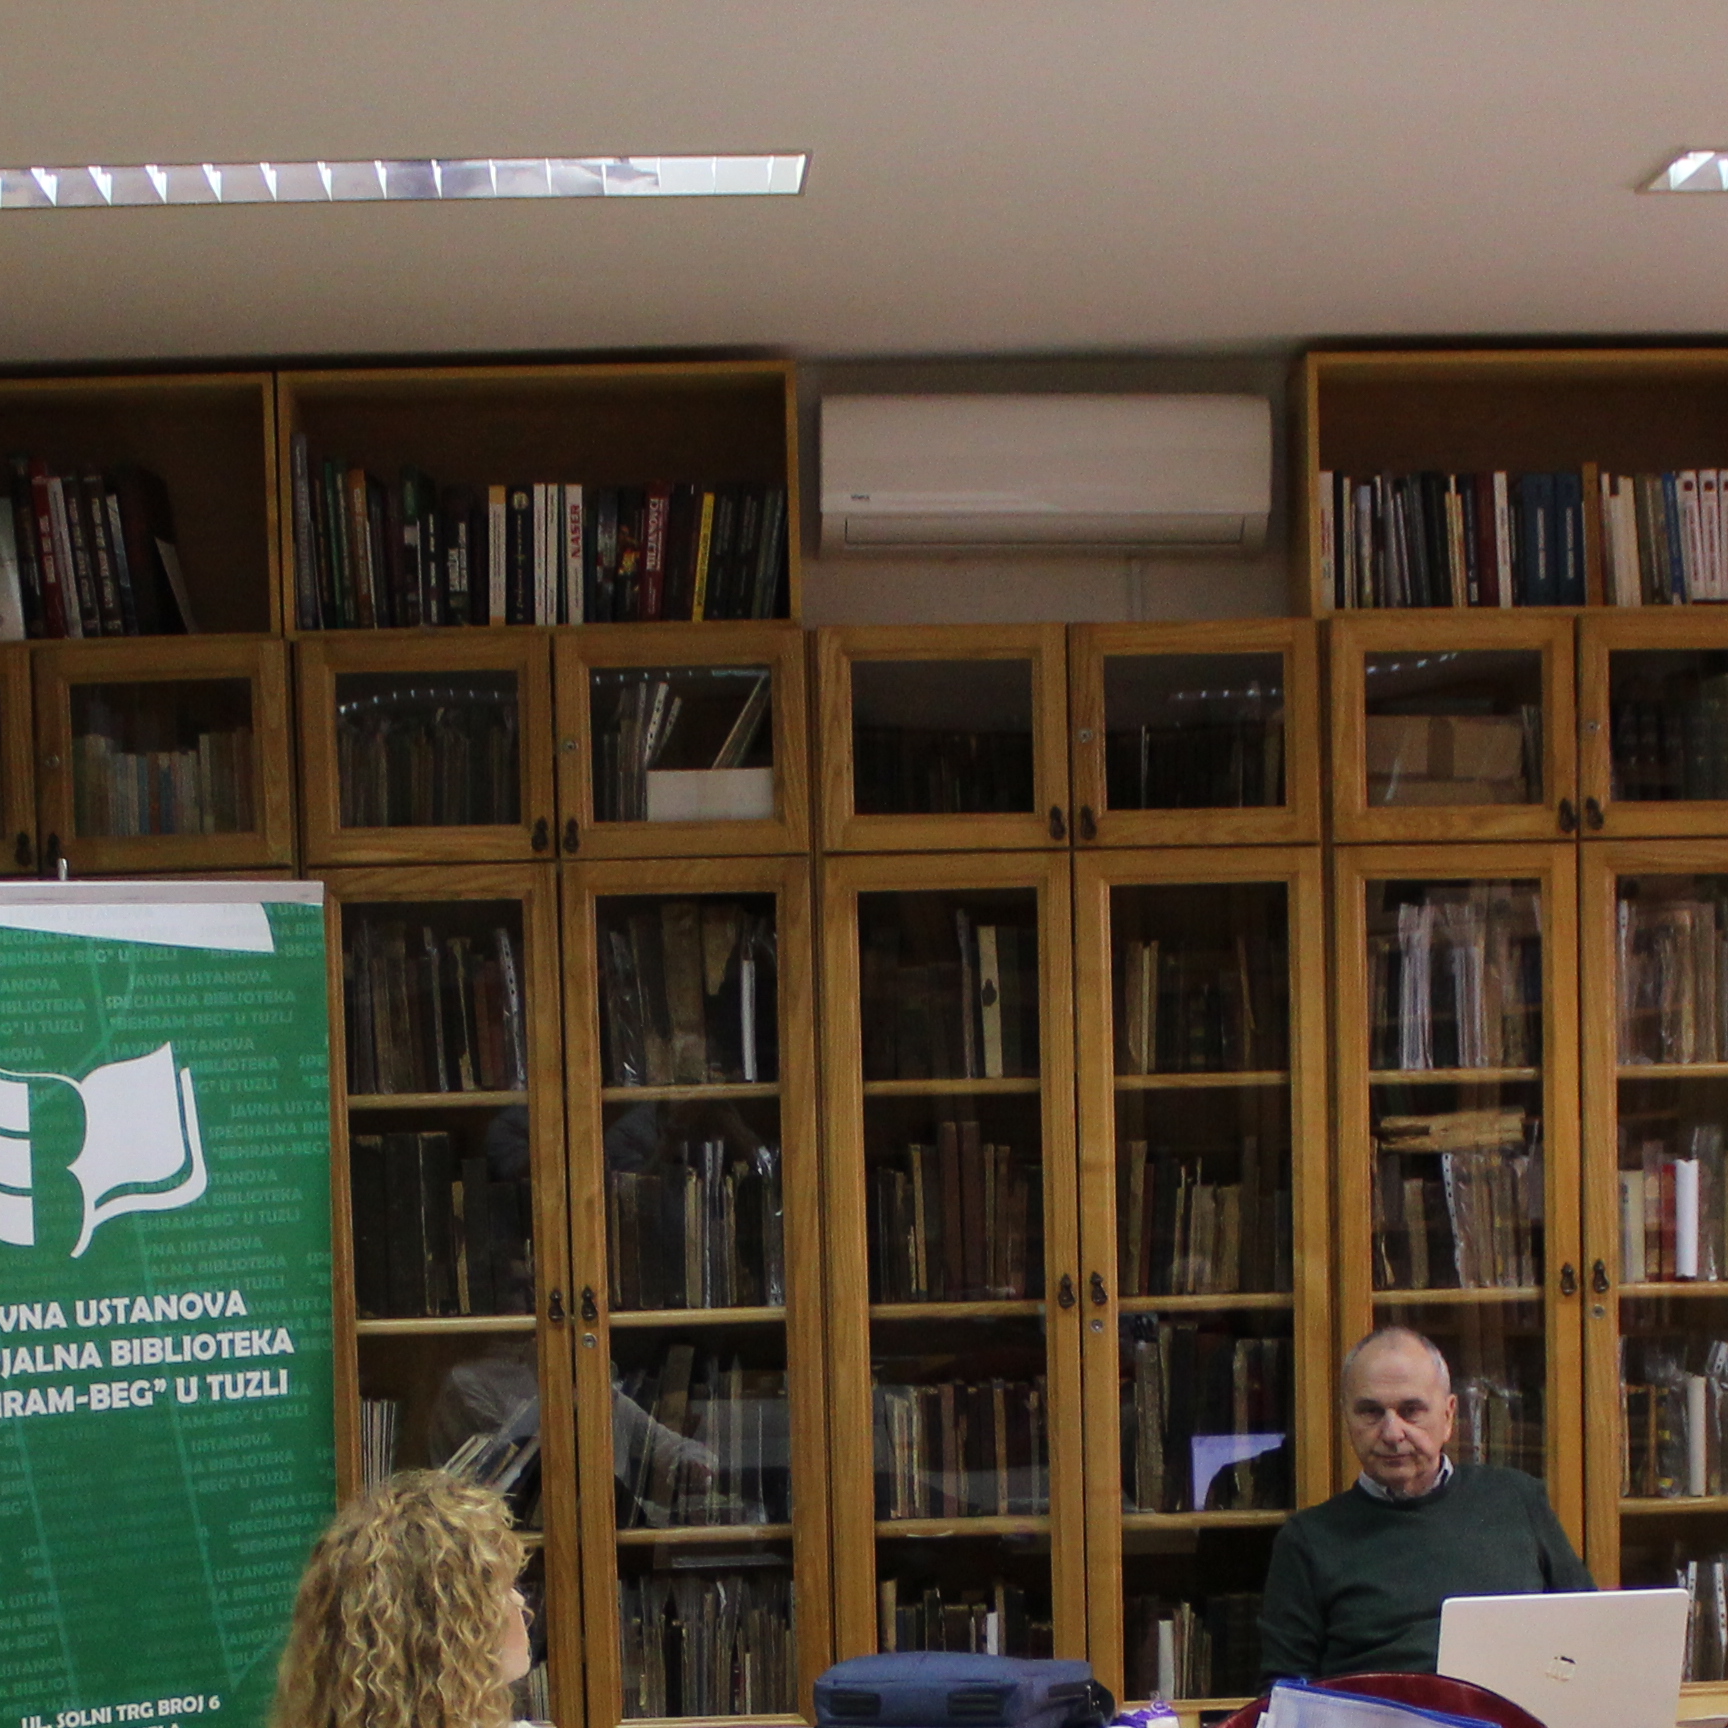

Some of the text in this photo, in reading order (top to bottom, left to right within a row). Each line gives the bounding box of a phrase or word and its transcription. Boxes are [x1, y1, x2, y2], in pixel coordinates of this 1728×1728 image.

[75, 1289, 247, 1327] USTANOVA
[110, 1327, 294, 1366] BIBLIOTEKA
[175, 1376, 198, 1403] U
[206, 1369, 288, 1400] TUZLI
[117, 1701, 154, 1722] TRG
[157, 1694, 204, 1719] BROJ
[208, 1694, 220, 1710] 6
